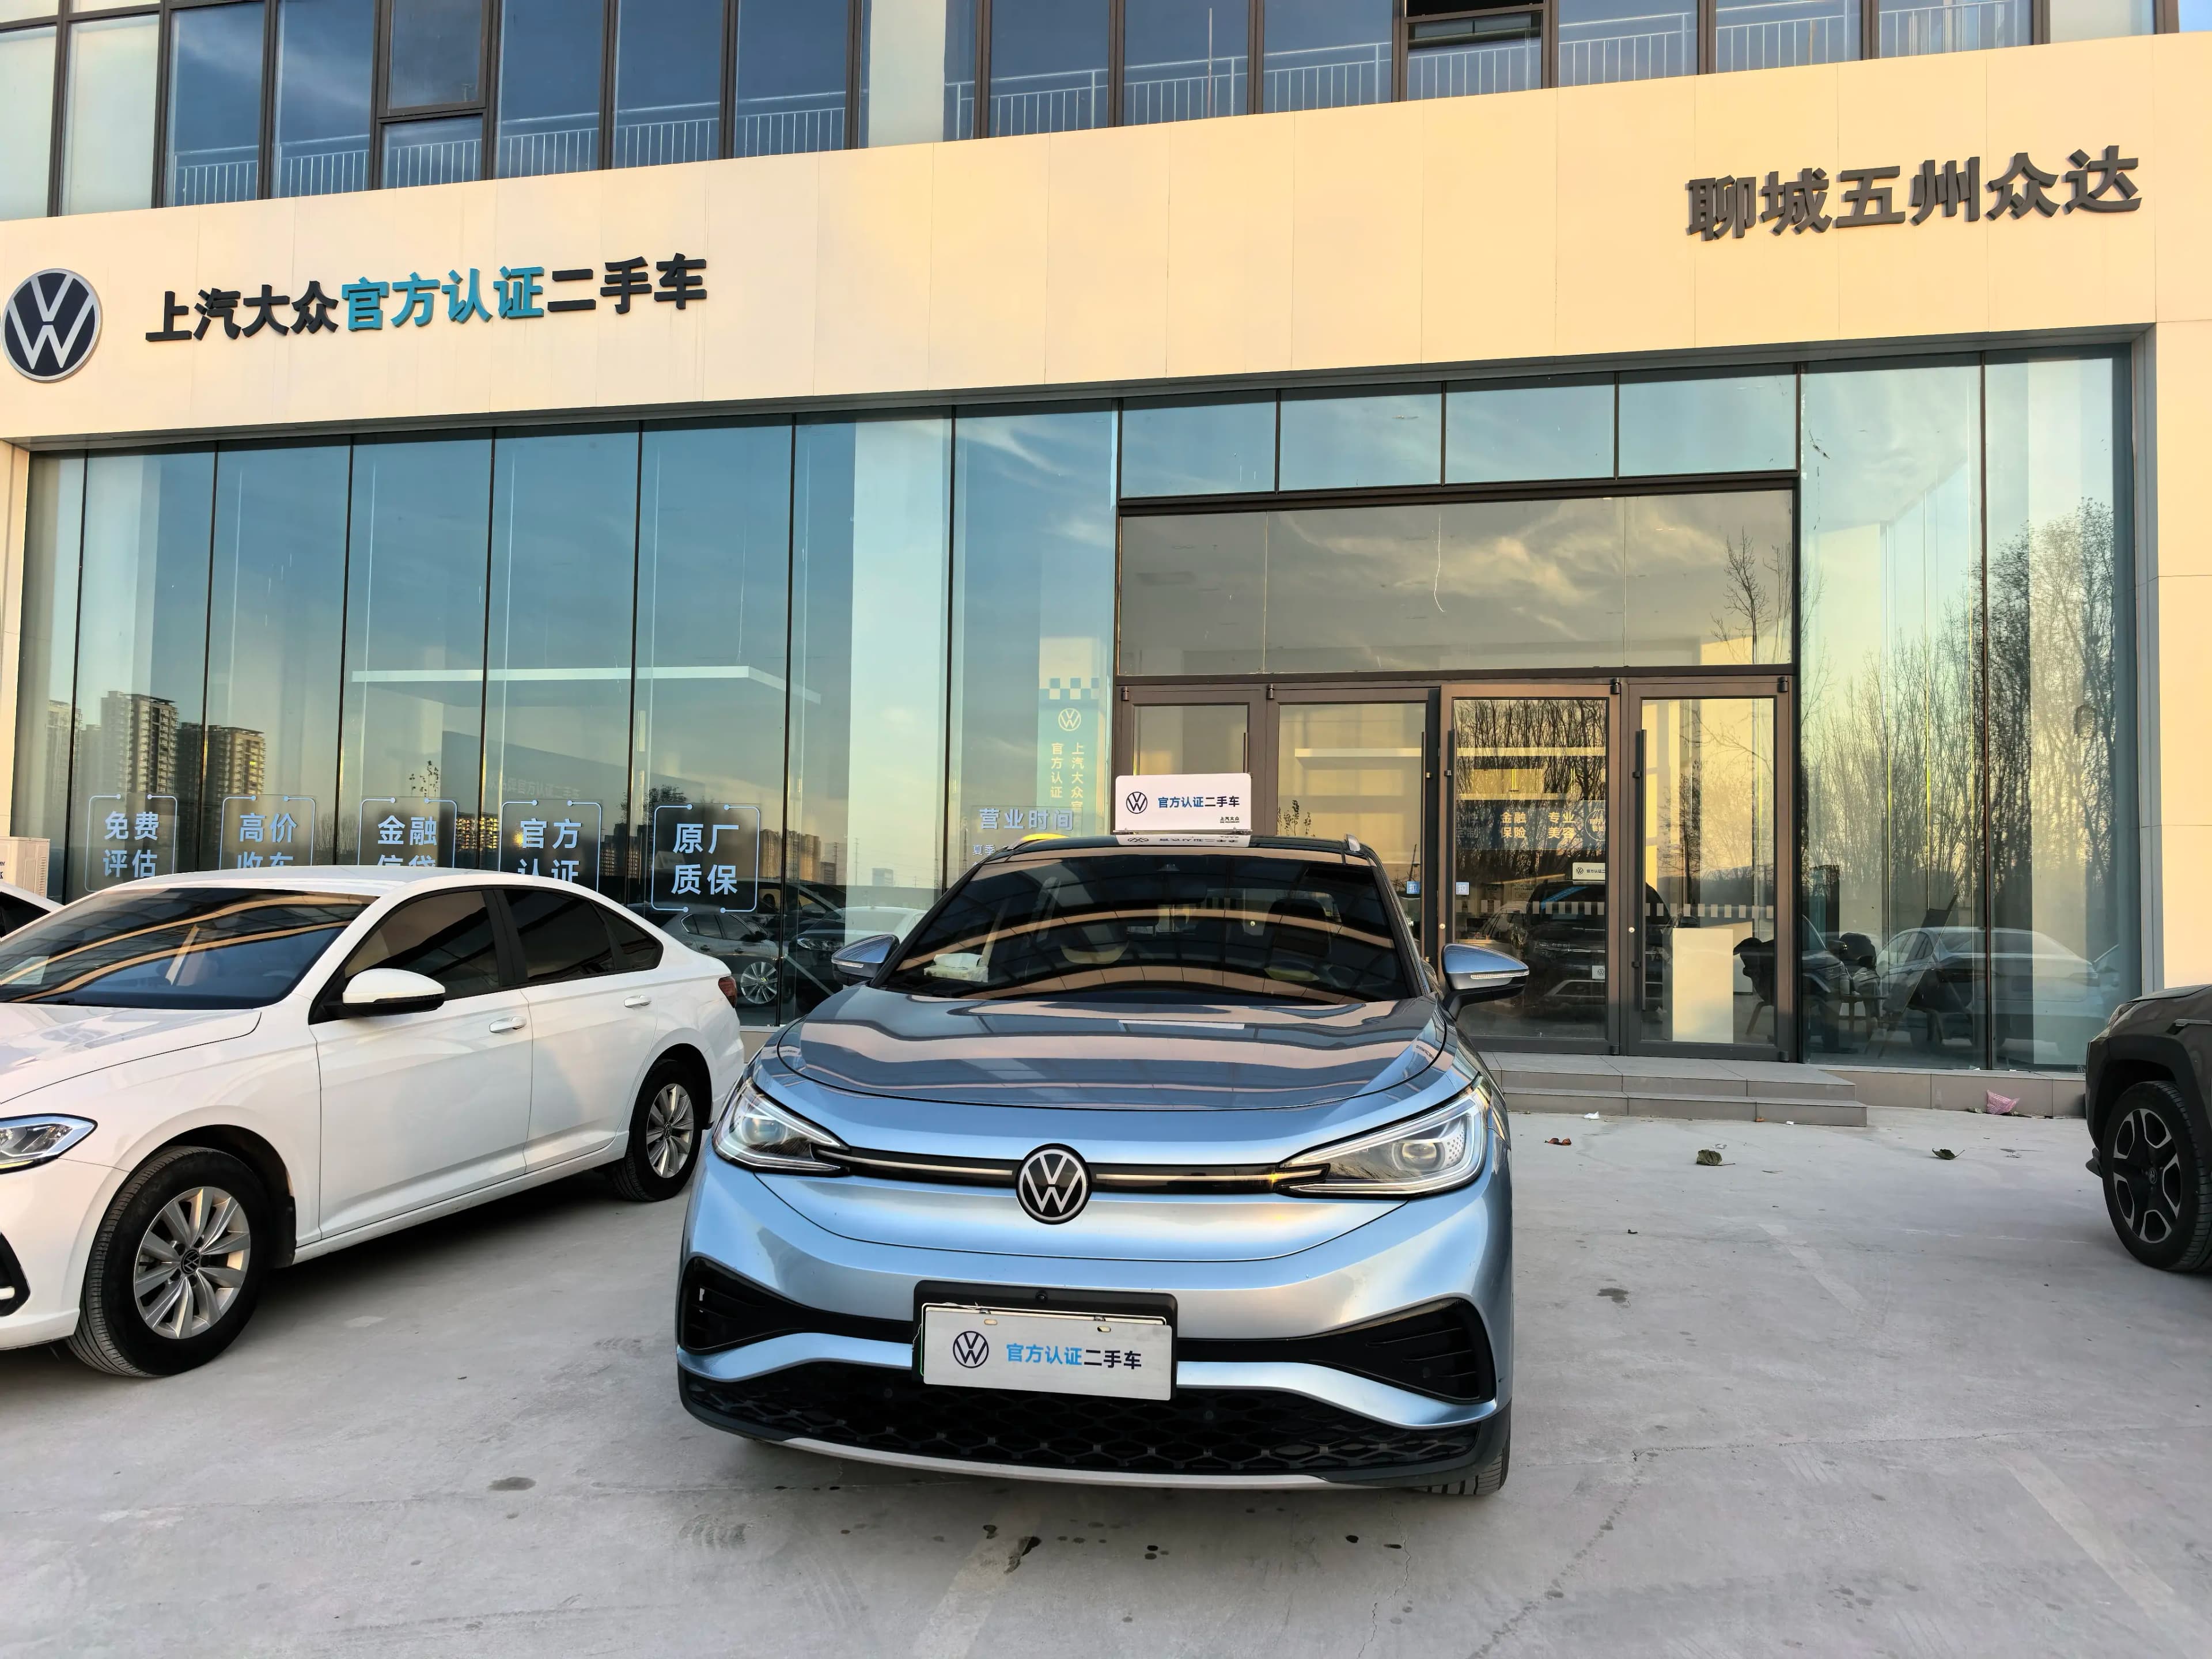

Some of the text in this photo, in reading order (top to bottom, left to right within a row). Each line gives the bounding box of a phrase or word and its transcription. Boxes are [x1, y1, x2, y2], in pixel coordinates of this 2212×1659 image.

[1685, 145, 2142, 241] 聊城五州众达
[145, 253, 707, 343] 上汽大众官方认证二手车
[1051, 743, 1063, 799] 官方认证
[1157, 795, 1240, 809] 官方认证二手车
[104, 811, 160, 840] 免费
[238, 813, 298, 844] 高价
[377, 815, 438, 846] 金融
[979, 808, 1074, 831] 营业时间
[1501, 812, 1527, 824] 金融
[1548, 812, 1575, 824] 专业
[520, 818, 583, 849] 官方
[673, 823, 740, 854] 原厂
[1501, 827, 1527, 839] 保险
[1548, 827, 1575, 839] 美容
[103, 849, 158, 878] 评估
[972, 844, 995, 856] 夏季
[671, 864, 738, 895] 质保
[1006, 1343, 1142, 1370] 官方认证二手车
